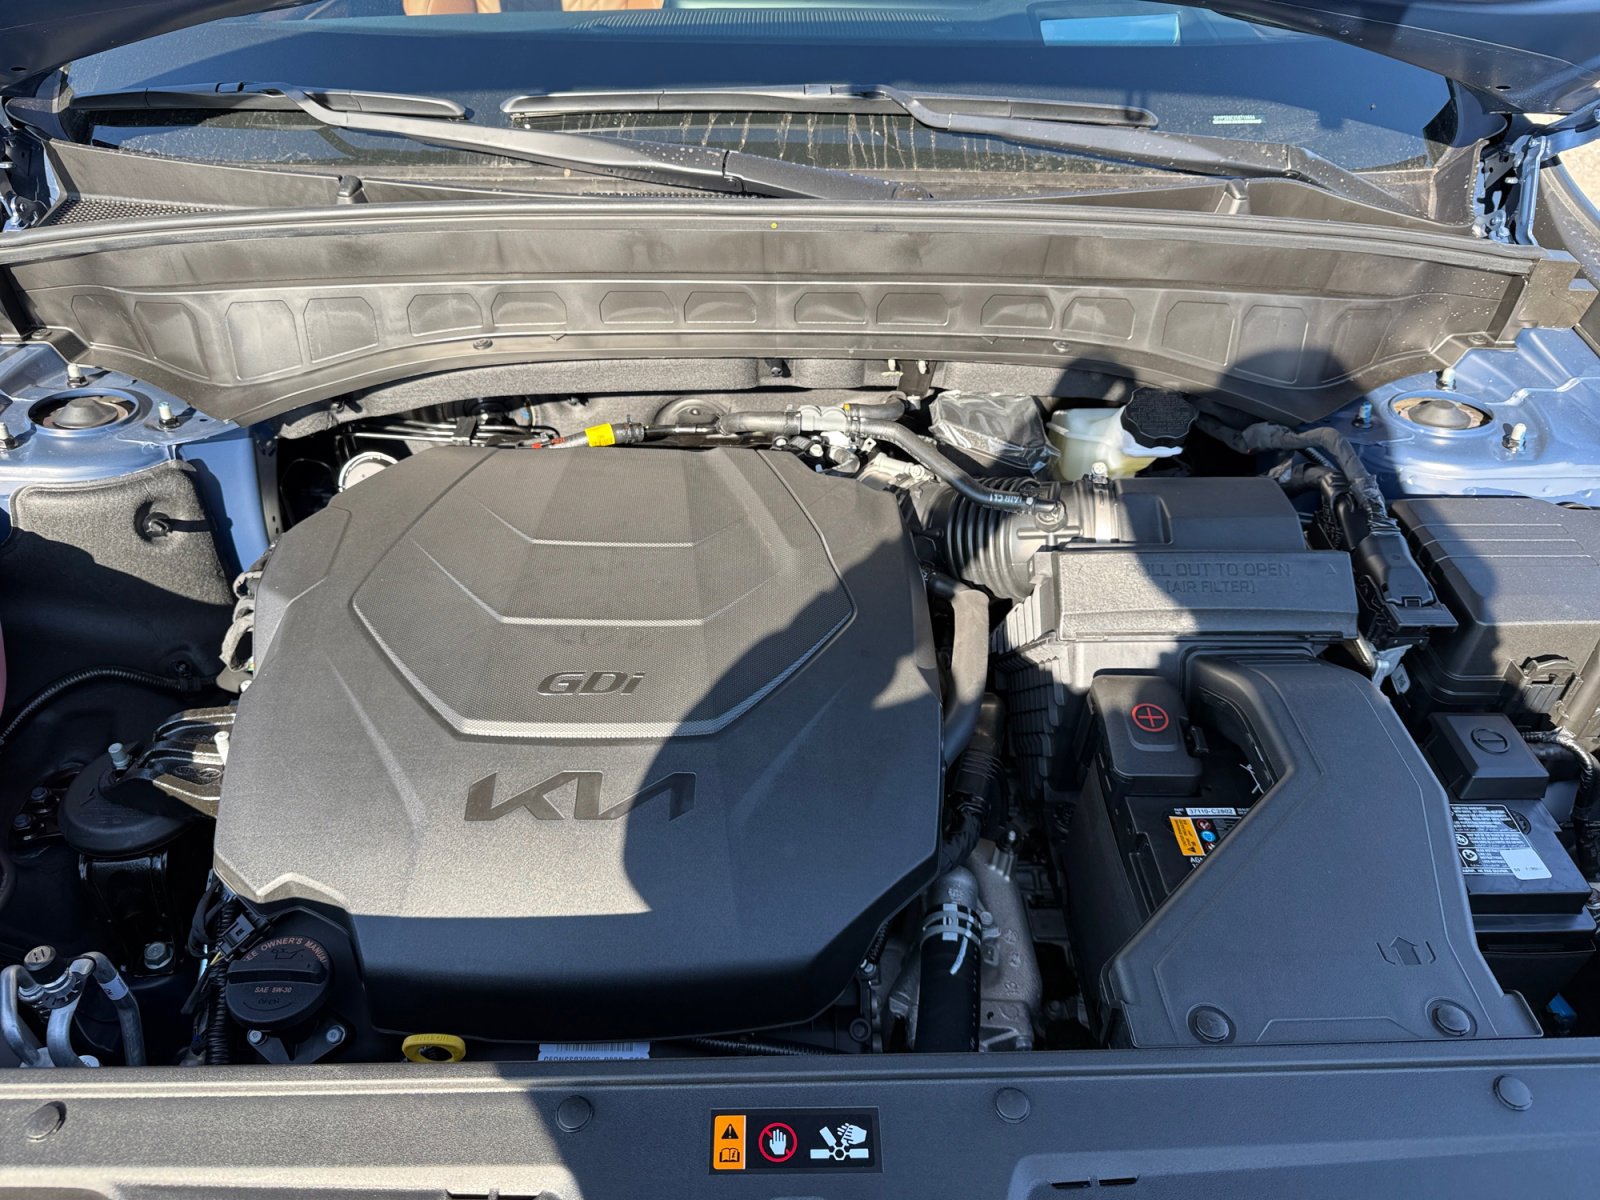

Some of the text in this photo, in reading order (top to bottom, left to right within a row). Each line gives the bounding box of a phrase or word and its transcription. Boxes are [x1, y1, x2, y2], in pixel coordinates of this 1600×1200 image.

[1176, 562, 1210, 577] OUT
[1215, 562, 1240, 577] TO
[1243, 562, 1291, 577] OPEN
[537, 671, 646, 696] GDi
[464, 770, 697, 822] KIA
[260, 937, 303, 951] OWNER'S
